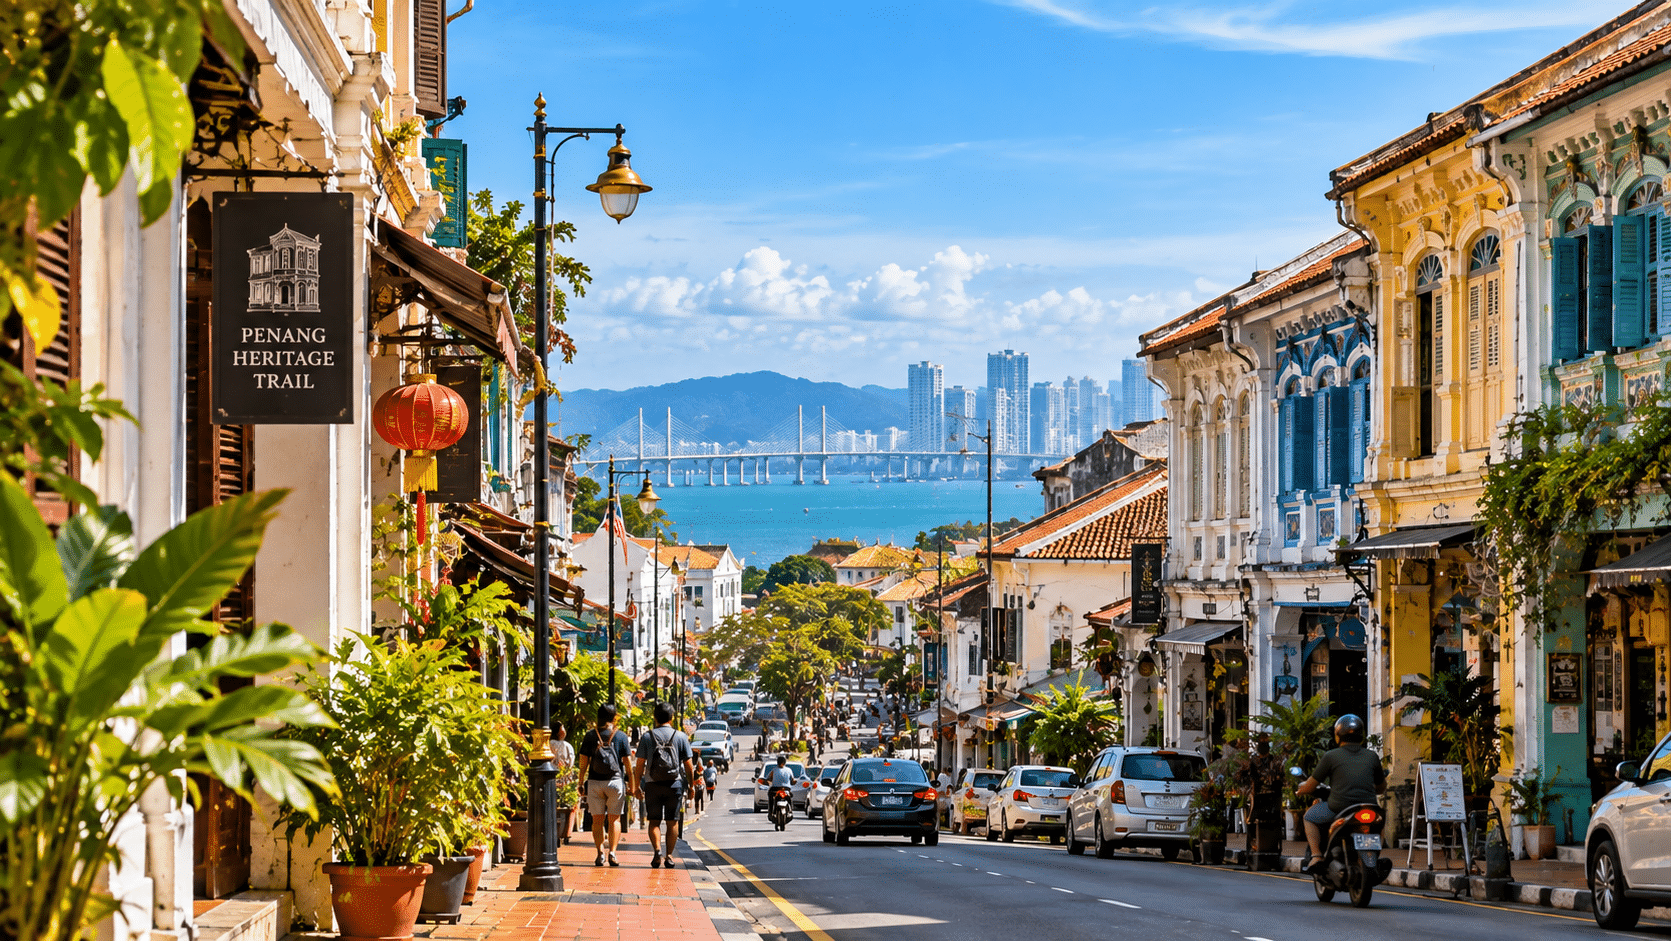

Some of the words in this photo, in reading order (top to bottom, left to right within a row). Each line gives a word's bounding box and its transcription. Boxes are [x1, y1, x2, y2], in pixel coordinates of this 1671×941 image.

[241, 327, 326, 344] PENANG
[232, 350, 335, 366] HERITAGE
[253, 373, 315, 389] TRAIL
